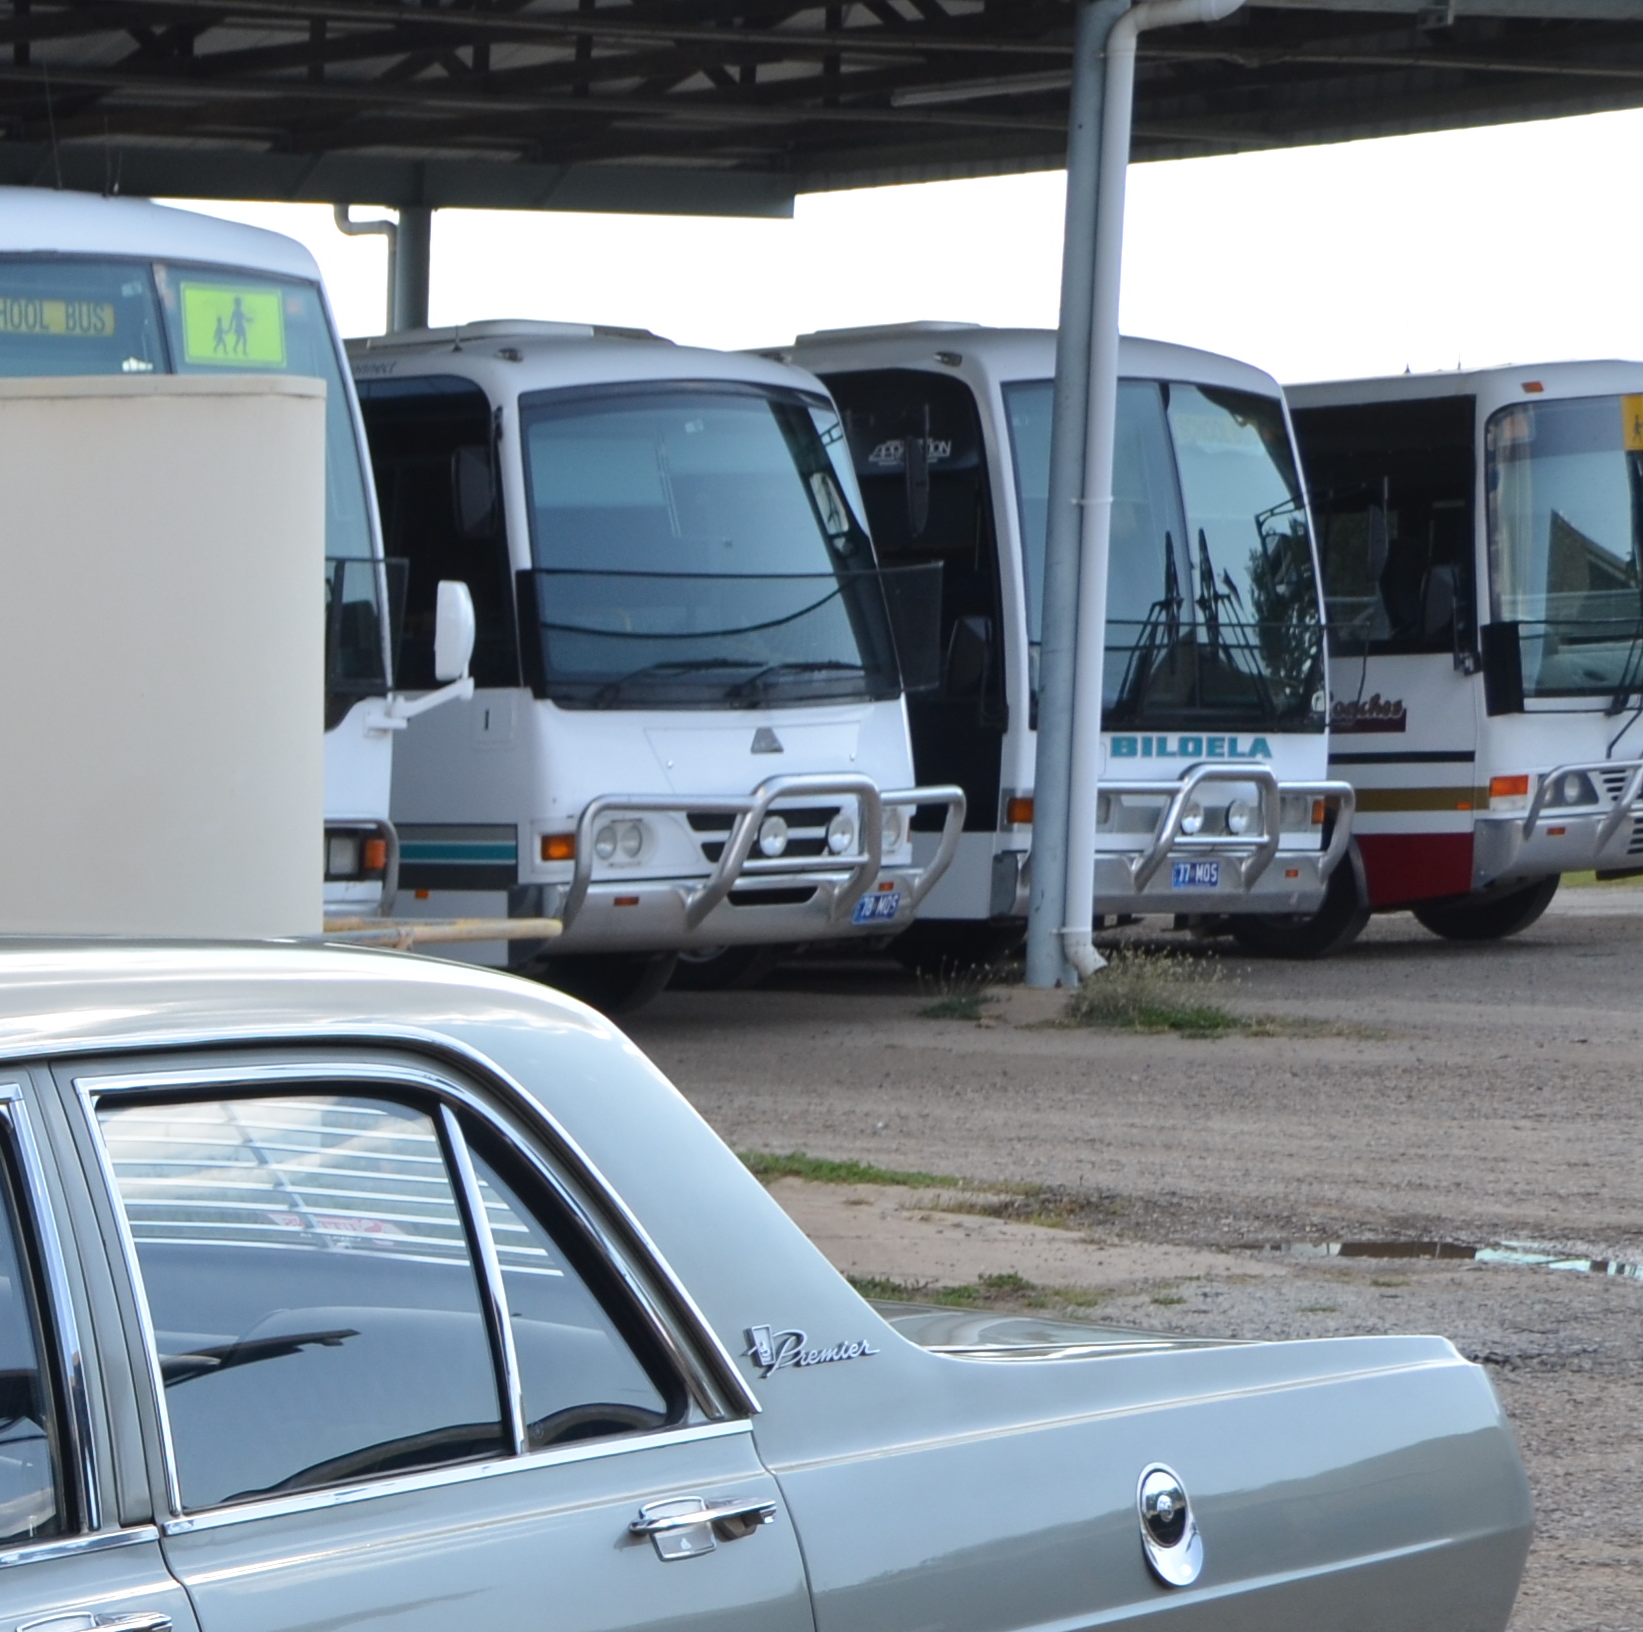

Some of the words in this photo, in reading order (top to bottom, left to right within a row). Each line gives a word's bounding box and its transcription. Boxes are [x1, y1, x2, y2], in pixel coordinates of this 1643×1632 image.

[65, 302, 106, 332] BUS
[1330, 690, 1403, 719] oaches
[1110, 735, 1272, 758] BILOELA
[1178, 864, 1191, 882] 77
[1195, 863, 1218, 883] MOS
[766, 1328, 881, 1377] Premier
